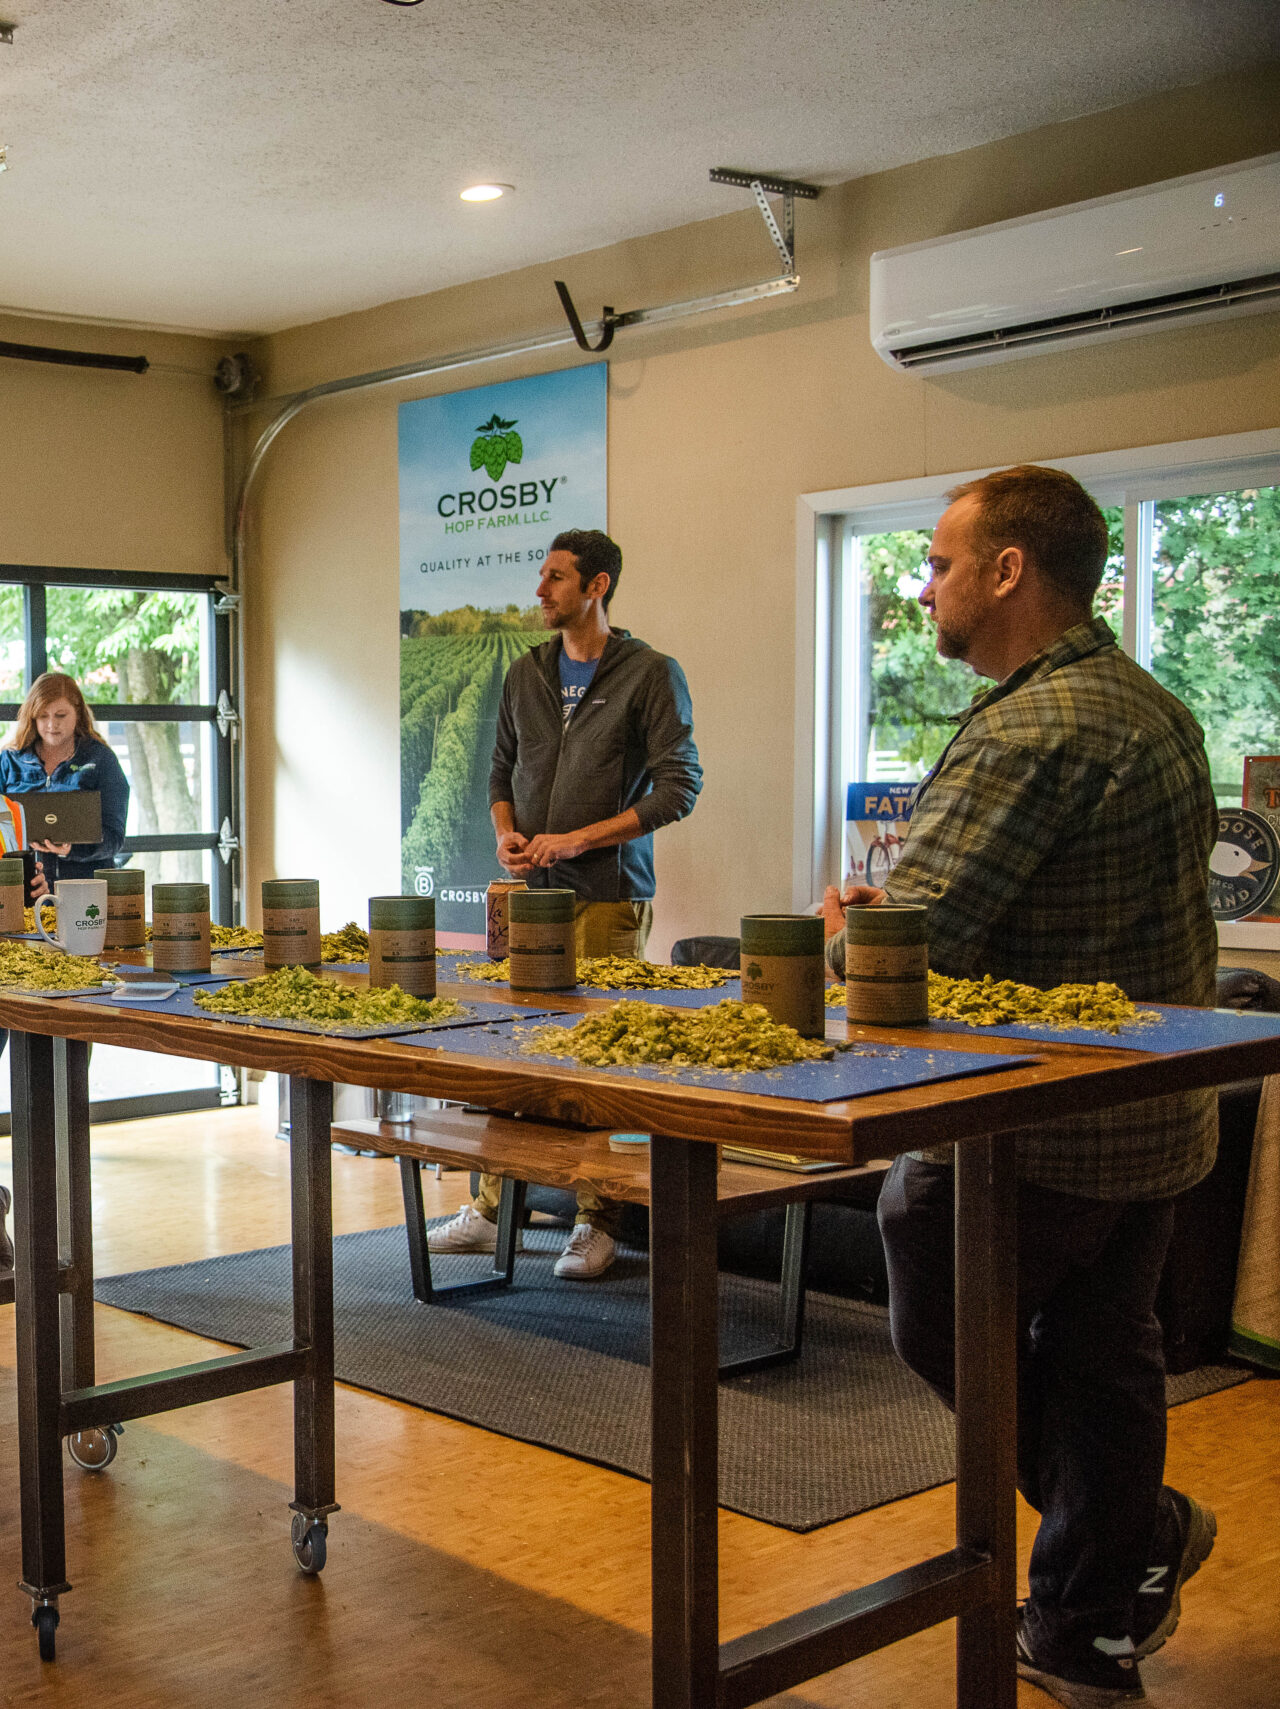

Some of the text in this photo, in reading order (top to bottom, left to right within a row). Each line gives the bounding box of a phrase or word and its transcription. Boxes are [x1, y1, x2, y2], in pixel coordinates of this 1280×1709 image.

[437, 477, 559, 518] CROSBY
[444, 519, 474, 535] HOP
[420, 558, 471, 573] QUALITY
[476, 555, 491, 567] AT
[497, 551, 521, 565] THE
[864, 796, 908, 815] FAT
[1219, 821, 1264, 850] OOSE
[441, 889, 487, 903] CROSBY
[1213, 889, 1249, 909] AND
